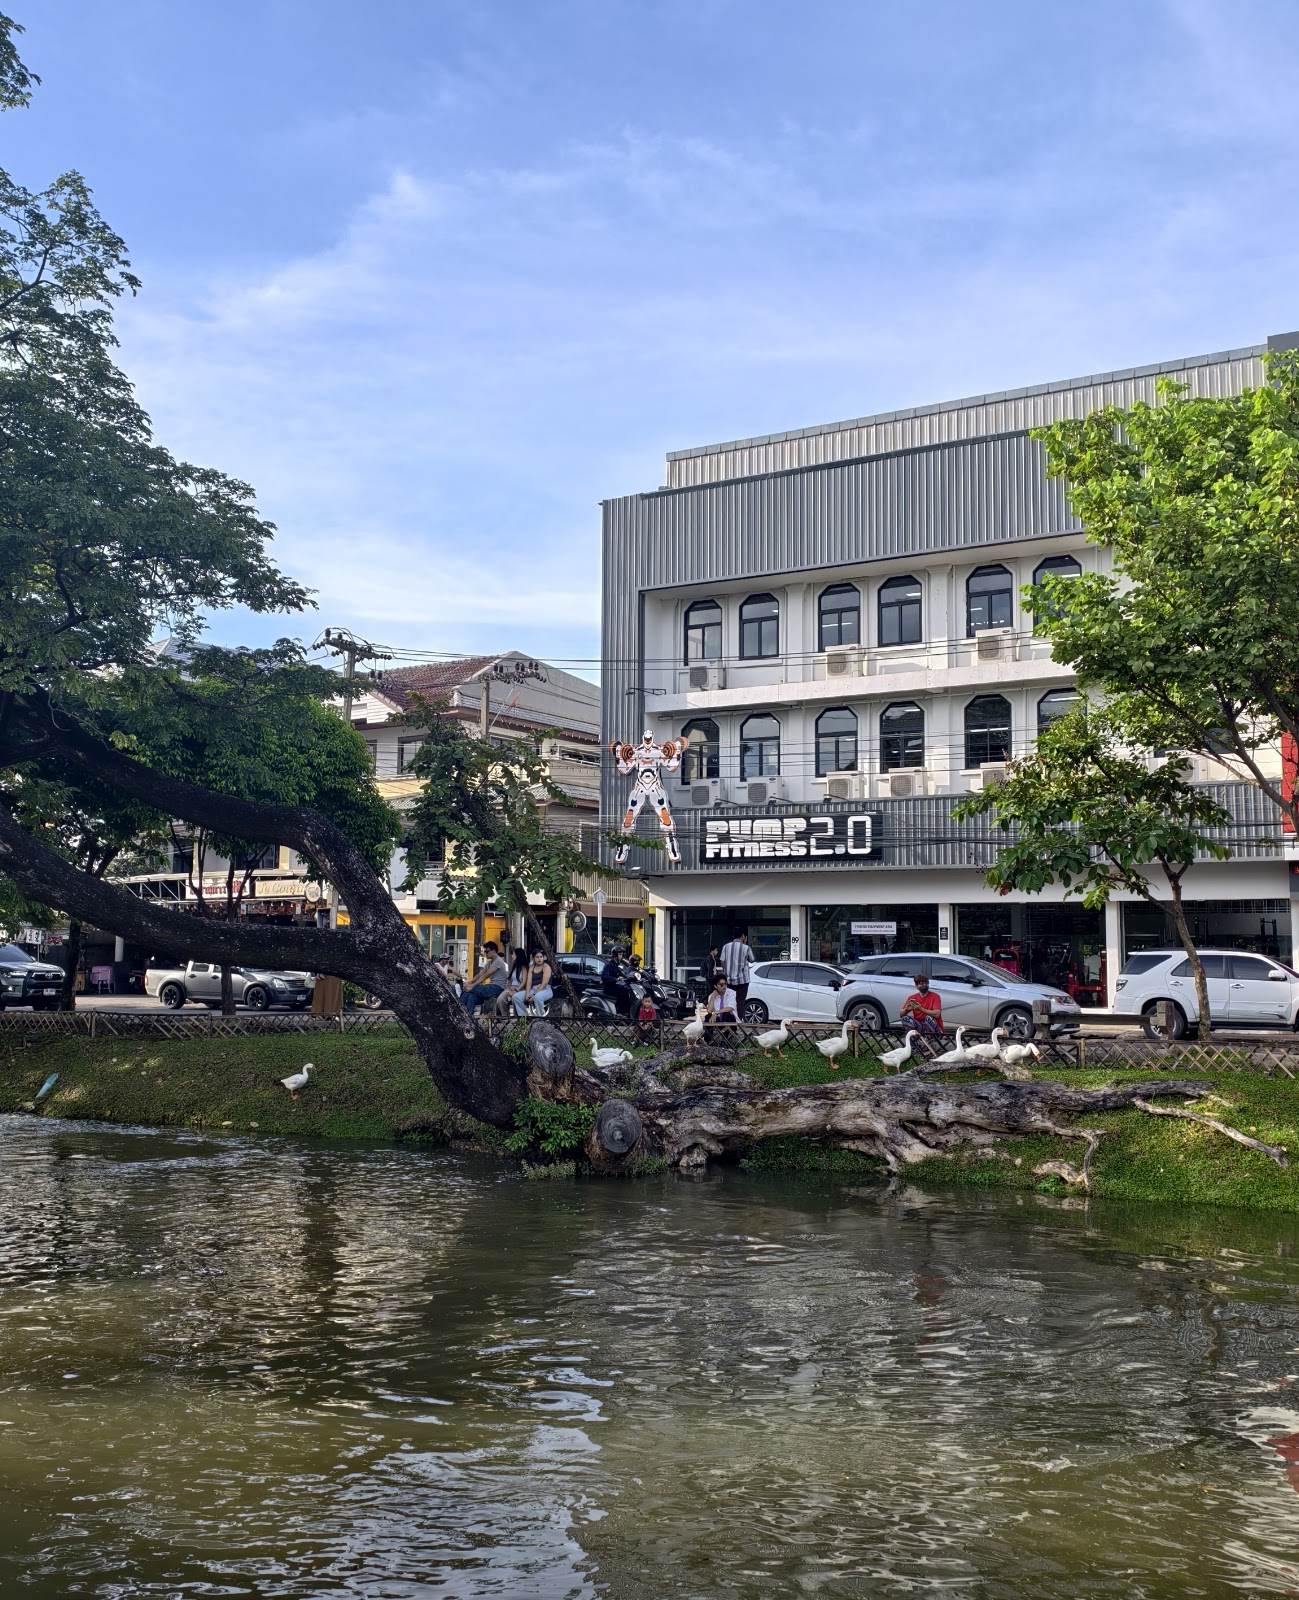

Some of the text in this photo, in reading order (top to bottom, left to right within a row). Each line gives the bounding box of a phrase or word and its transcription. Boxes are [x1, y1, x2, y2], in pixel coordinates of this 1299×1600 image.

[705, 818, 808, 842] PUMP
[809, 815, 873, 856] 2.0
[705, 841, 808, 858] FITNESS
